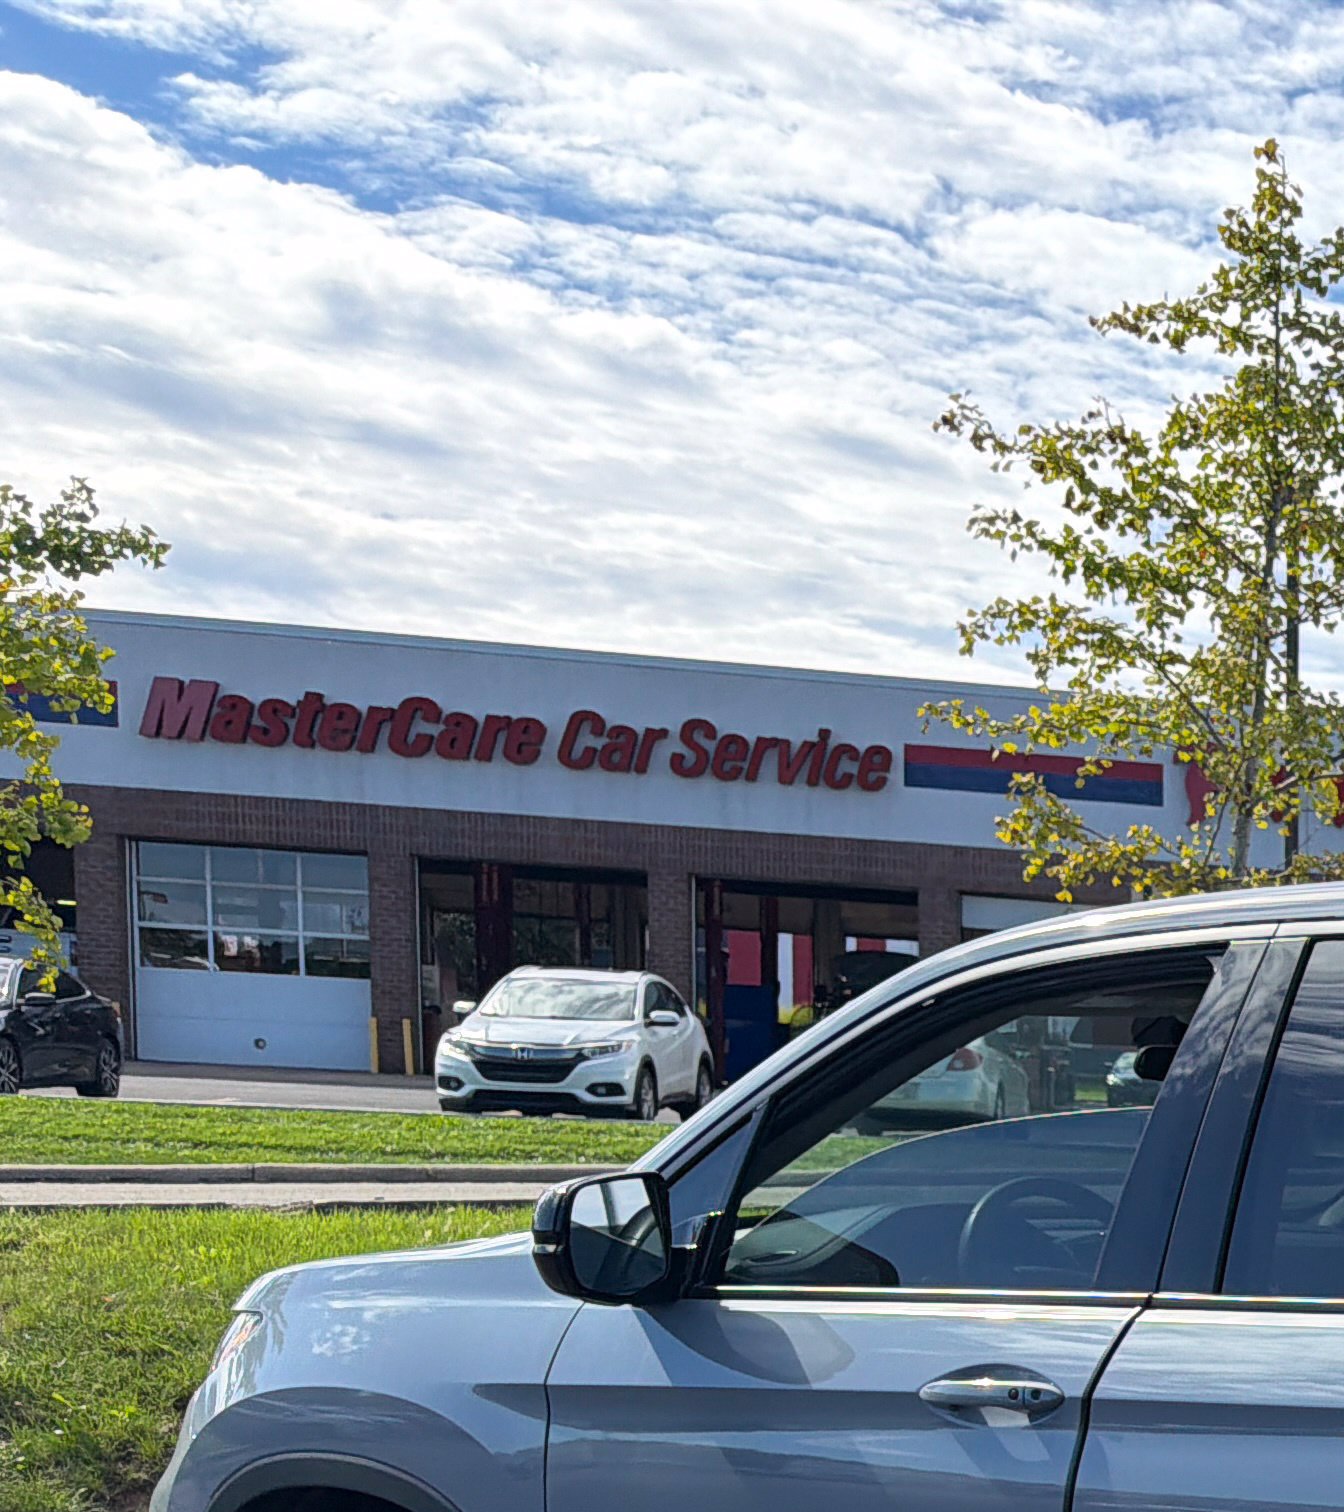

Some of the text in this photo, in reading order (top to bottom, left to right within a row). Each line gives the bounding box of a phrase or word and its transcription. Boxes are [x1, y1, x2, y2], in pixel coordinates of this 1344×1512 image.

[139, 676, 893, 792] MasterCare Car Service
